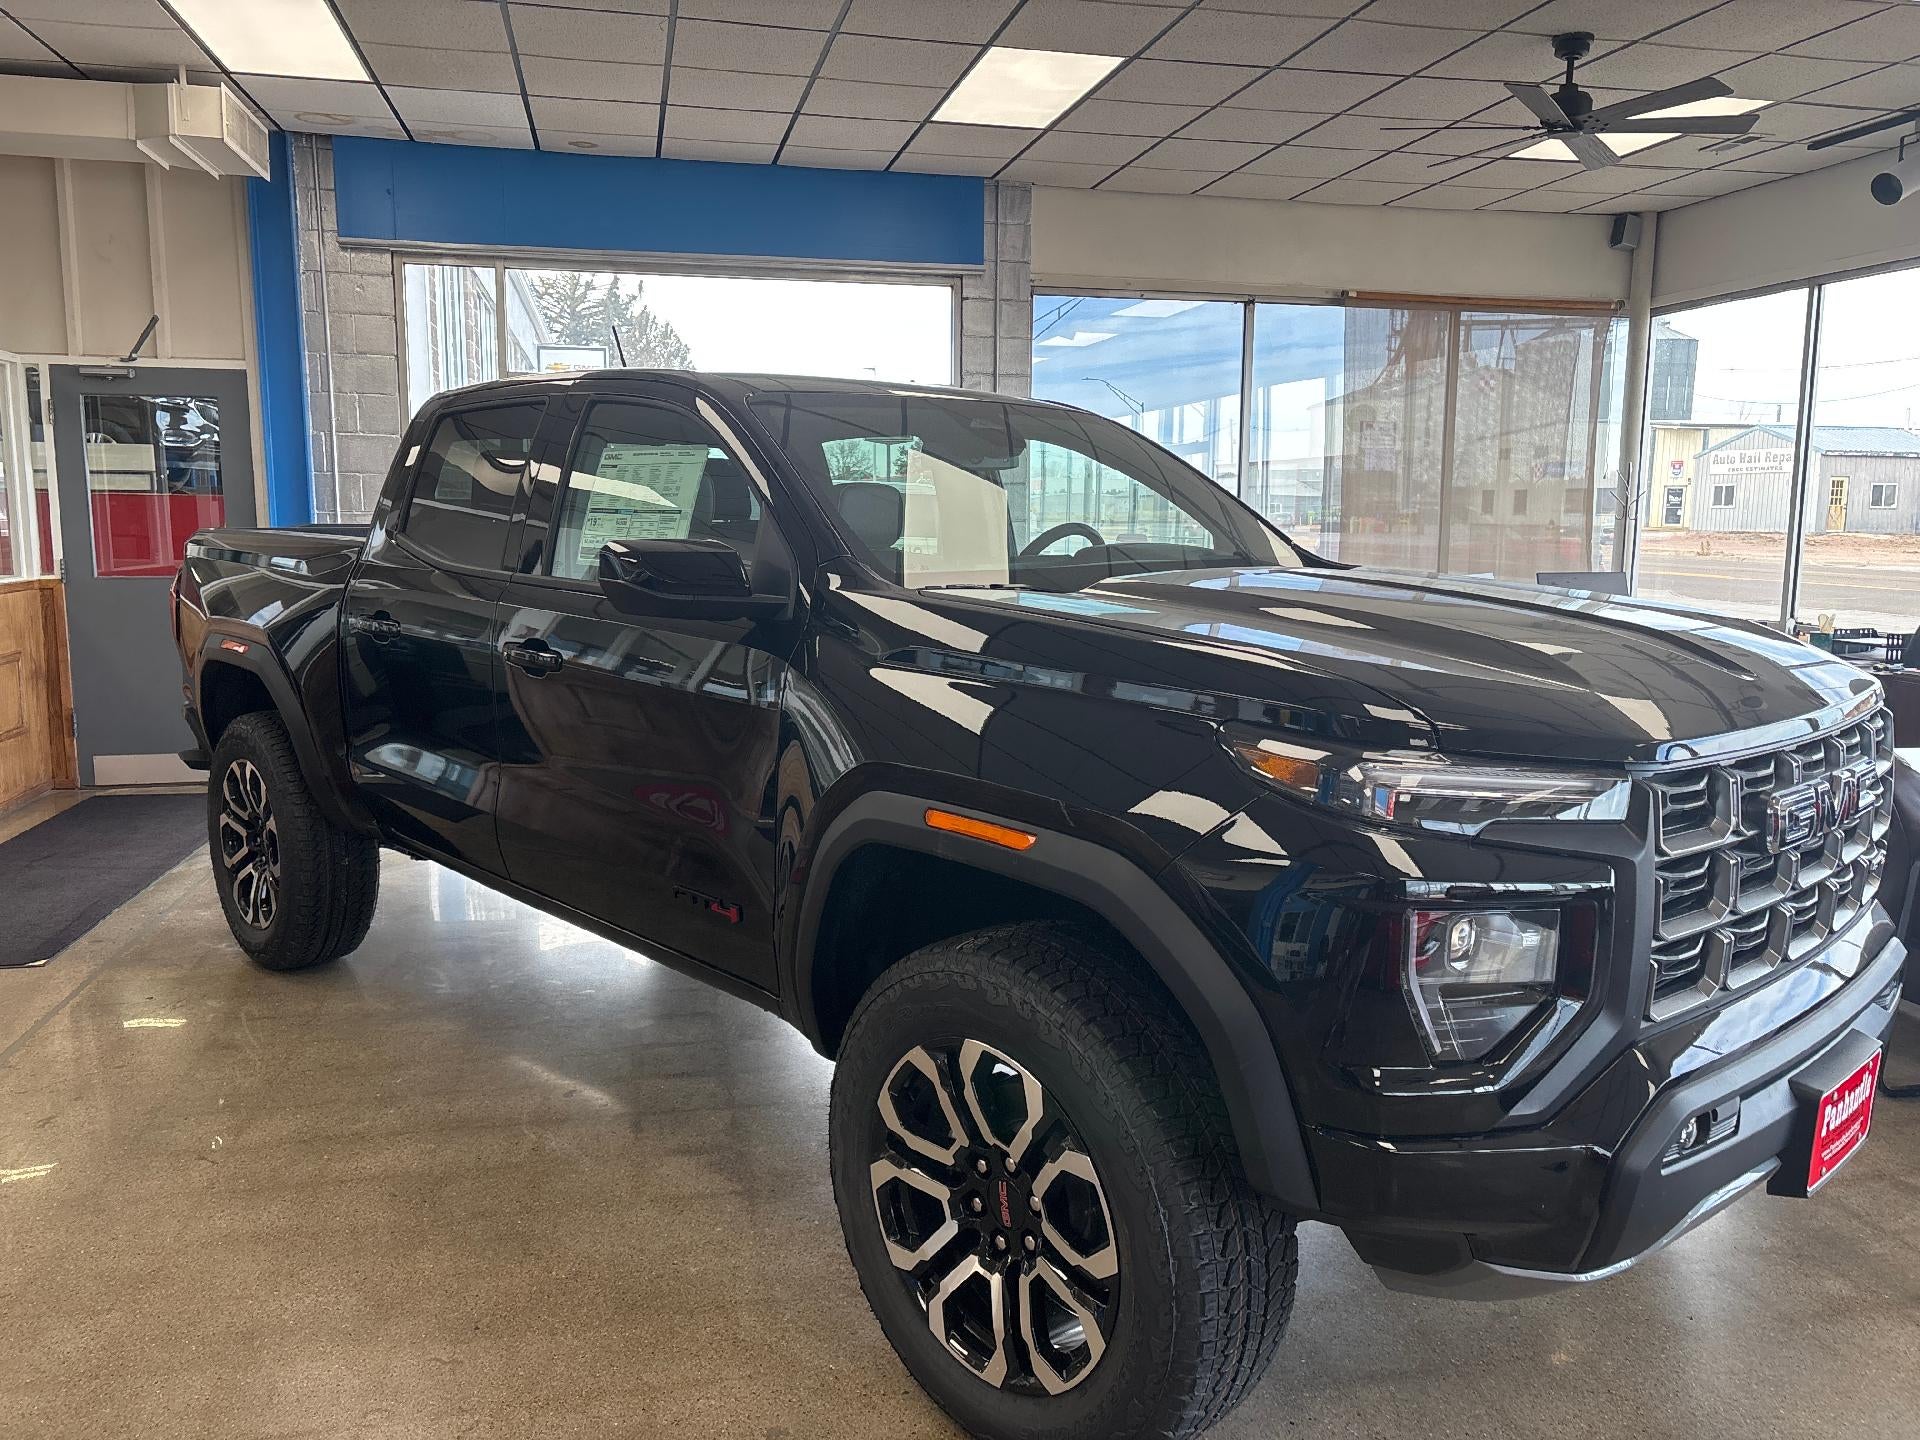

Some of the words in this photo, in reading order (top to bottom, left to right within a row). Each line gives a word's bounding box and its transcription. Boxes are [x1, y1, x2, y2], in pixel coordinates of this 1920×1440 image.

[604, 453, 623, 461] GMC
[1712, 453, 1736, 465] Auto
[1739, 452, 1761, 464] Hail
[1764, 451, 1792, 465] Repa
[1767, 759, 1876, 854] GMC
[1820, 1071, 1873, 1138] Panhandle
[998, 1180, 1012, 1228] GMC
